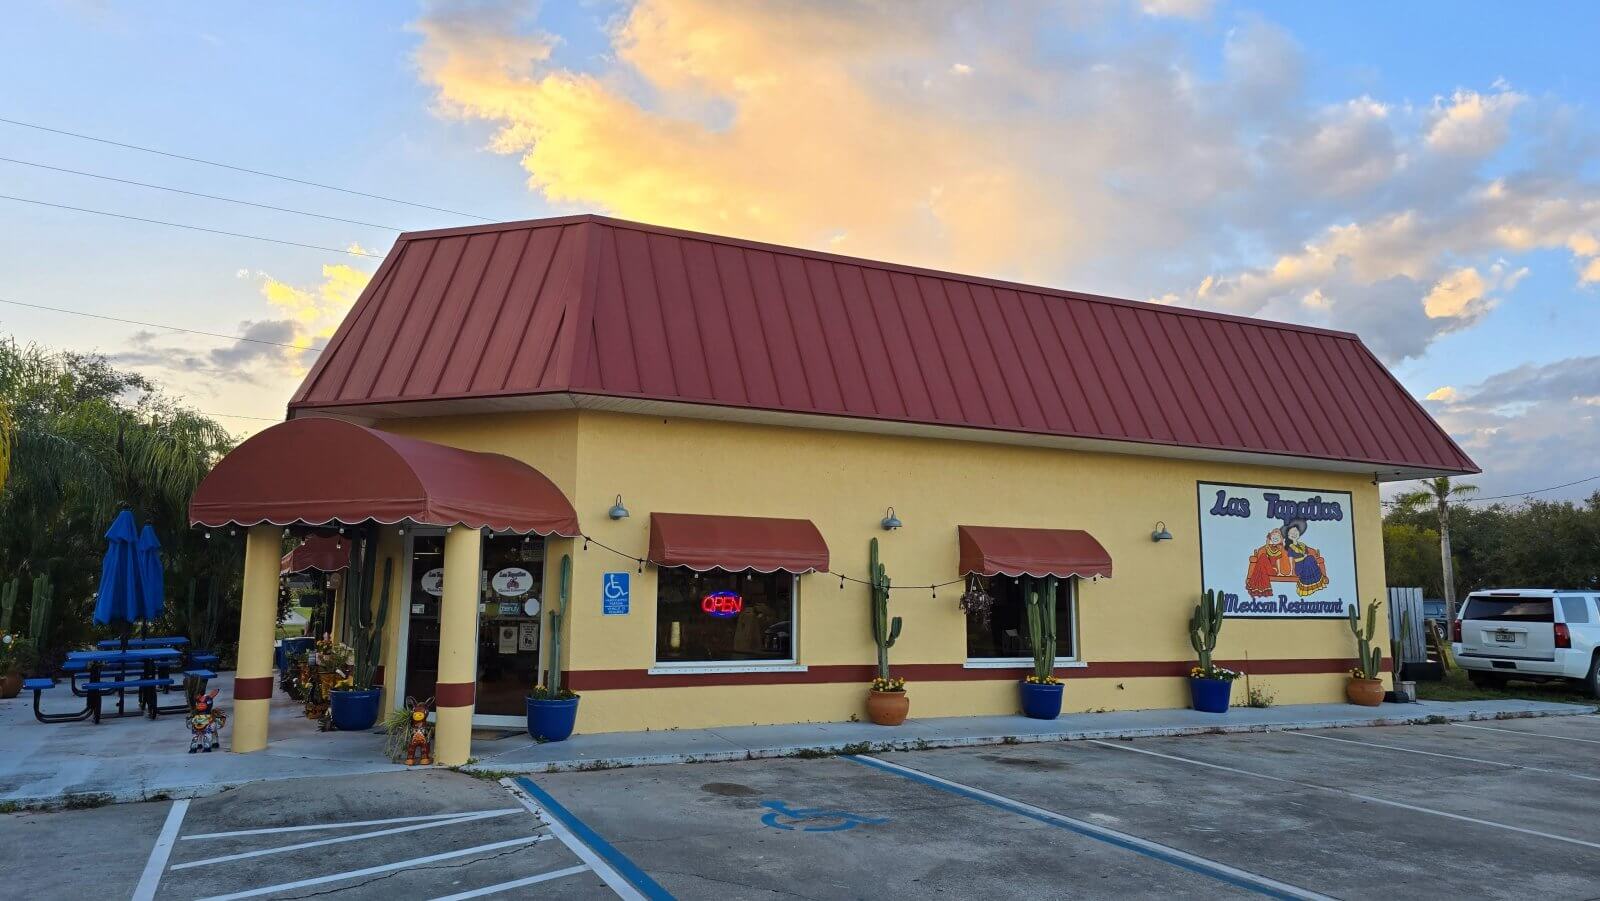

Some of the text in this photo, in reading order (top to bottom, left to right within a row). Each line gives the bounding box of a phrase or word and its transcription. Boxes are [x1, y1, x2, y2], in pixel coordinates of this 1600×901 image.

[1210, 489, 1343, 526] Las Tapatias
[702, 596, 743, 613] OPEN
[1224, 593, 1344, 614] Mexican Restaurant
